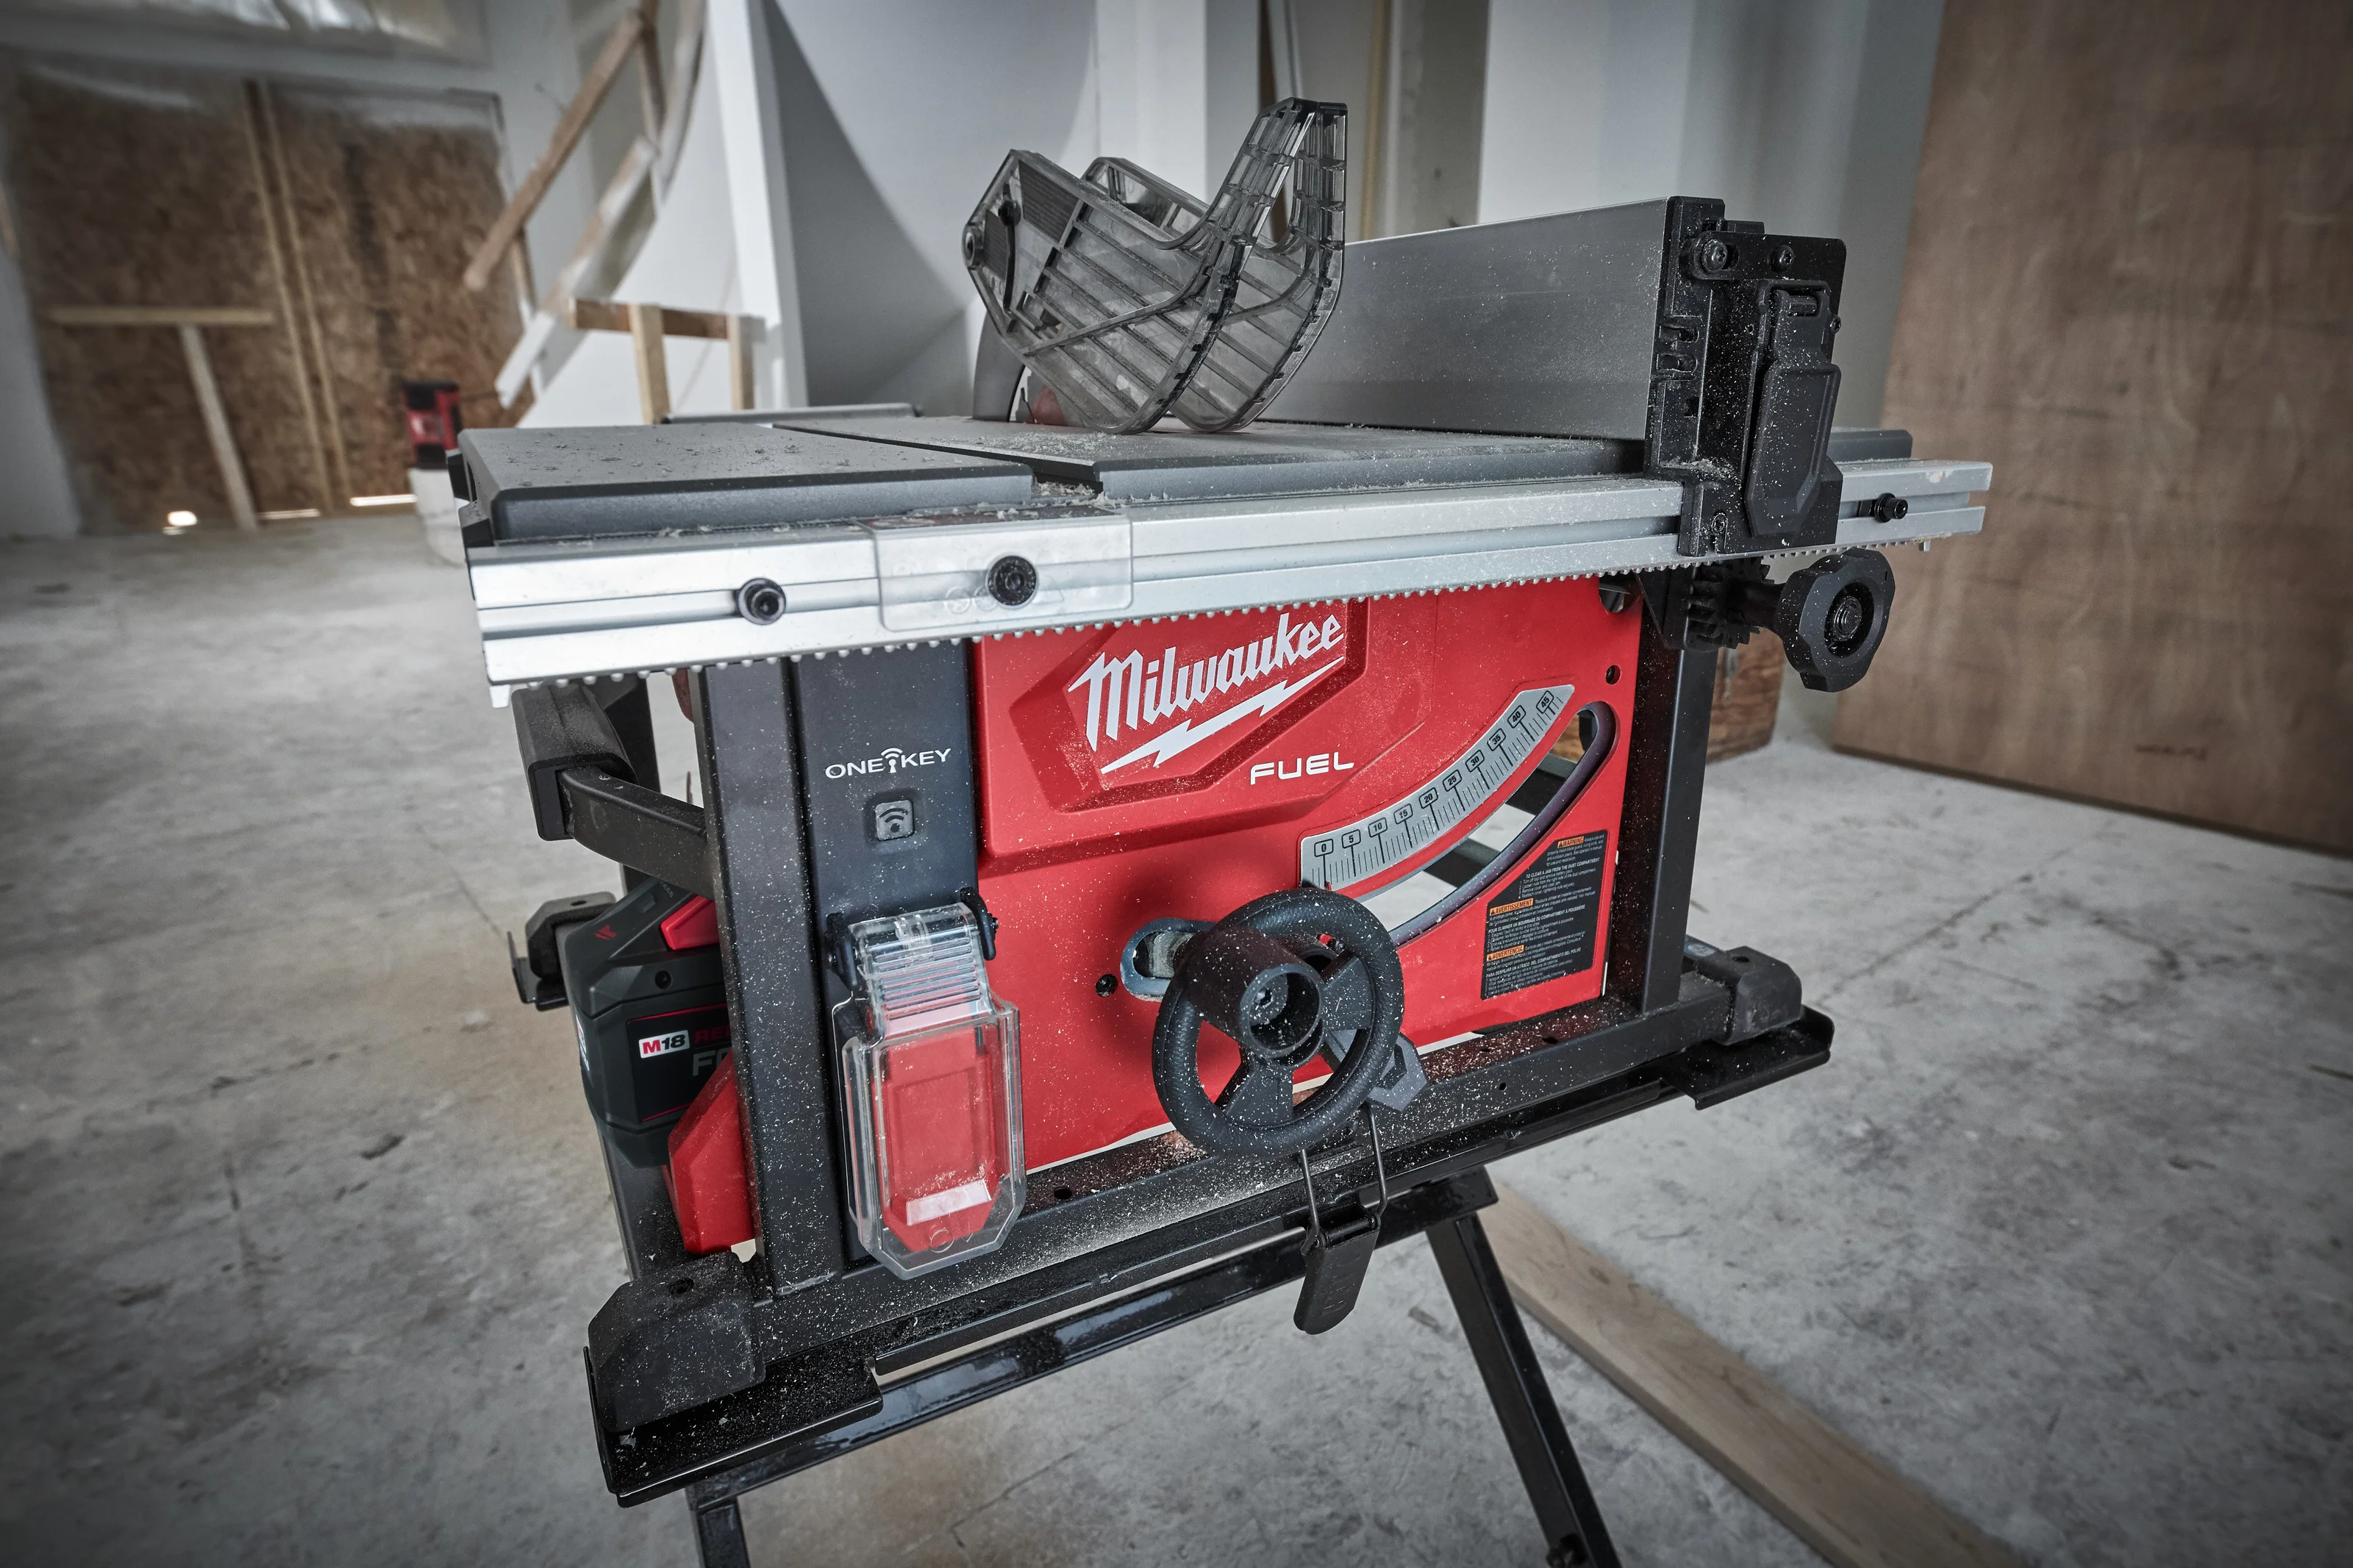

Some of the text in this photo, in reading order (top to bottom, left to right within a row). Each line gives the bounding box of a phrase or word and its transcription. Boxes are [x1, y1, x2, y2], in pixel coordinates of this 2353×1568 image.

[1068, 612, 1344, 751] Milwaukee
[1512, 711, 1521, 722] 40
[1492, 734, 1502, 745] 35
[1471, 756, 1479, 767] 30
[1250, 751, 1354, 785] FUEL
[1448, 776, 1457, 785] 25
[1424, 793, 1434, 803] 20
[1399, 809, 1408, 818] 15
[1373, 823, 1382, 832] 10
[1349, 834, 1354, 844] 5
[1562, 838, 1583, 847] WARNING
[1321, 843, 1327, 853] 0
[1495, 899, 1532, 914] AVERTISSEMENT
[1492, 946, 1522, 959] ADVERTENCIA
[642, 1034, 686, 1055] M18
